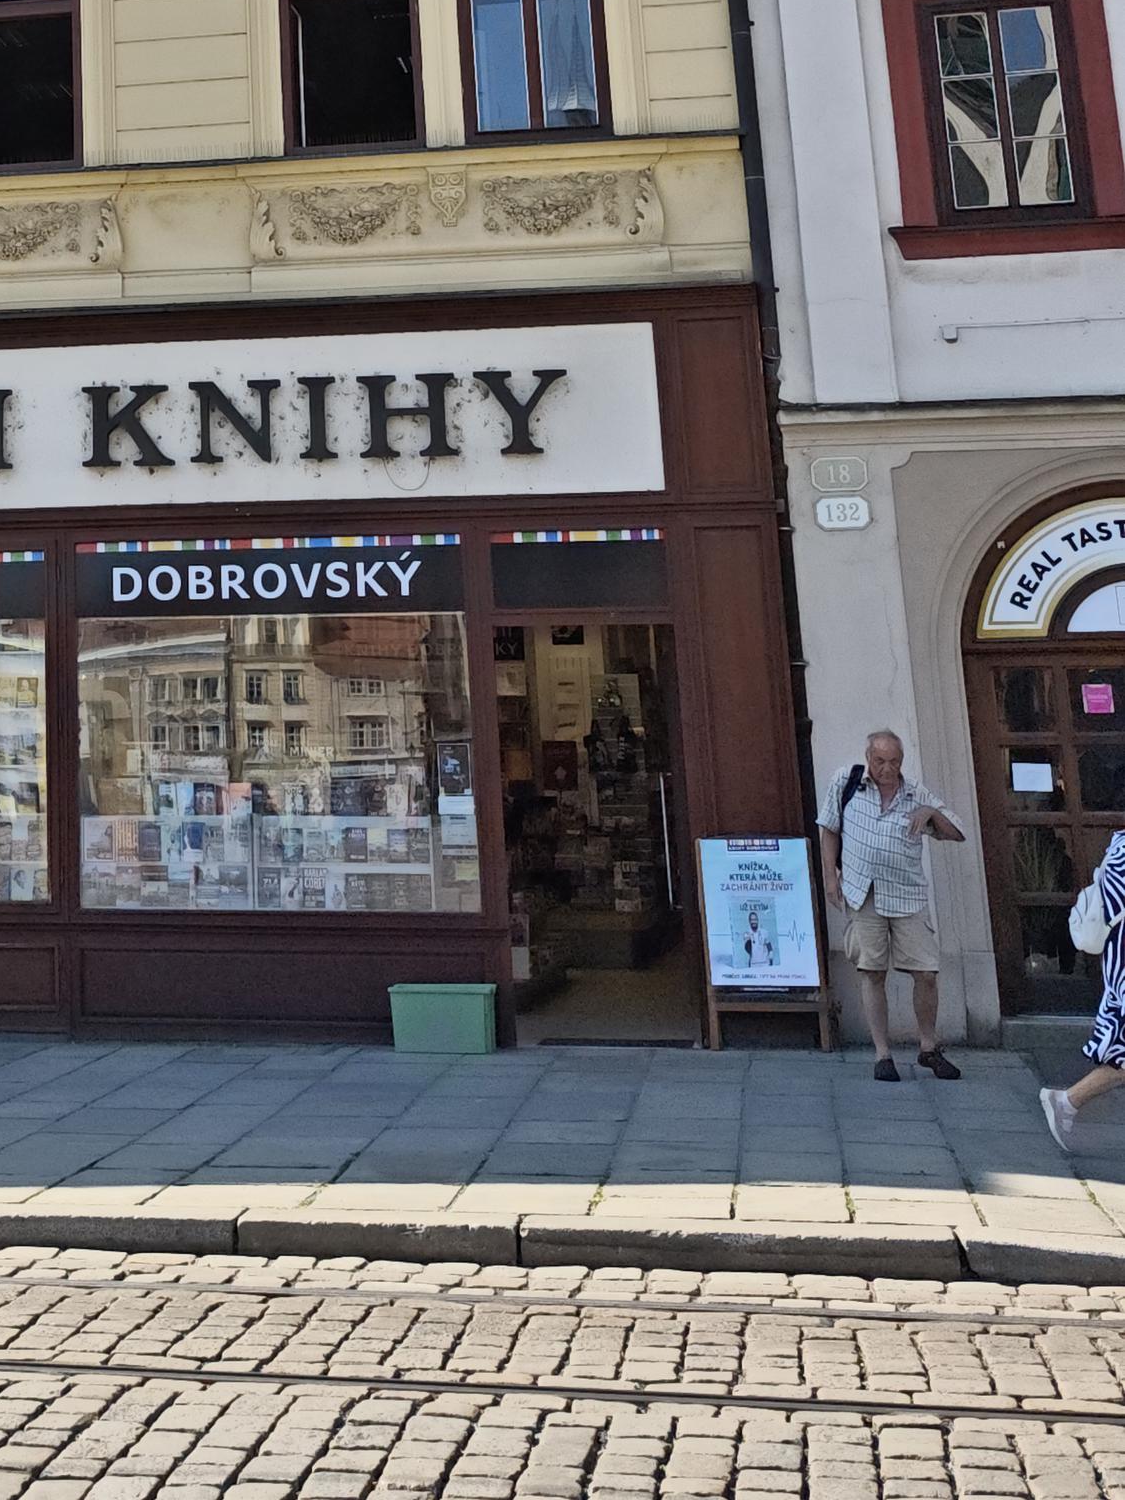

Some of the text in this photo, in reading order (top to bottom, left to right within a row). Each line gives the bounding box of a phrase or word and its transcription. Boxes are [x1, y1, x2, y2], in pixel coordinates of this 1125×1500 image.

[81, 369, 568, 468] KNIHY
[827, 464, 851, 484] 18
[825, 502, 861, 523] 132
[111, 551, 423, 602] DOBROVSKÝ
[1009, 550, 1063, 611] REAL
[729, 870, 784, 881] KTERÁ MŮŽE
[720, 882, 794, 892] ZACHRÁNIT ŽIVOT
